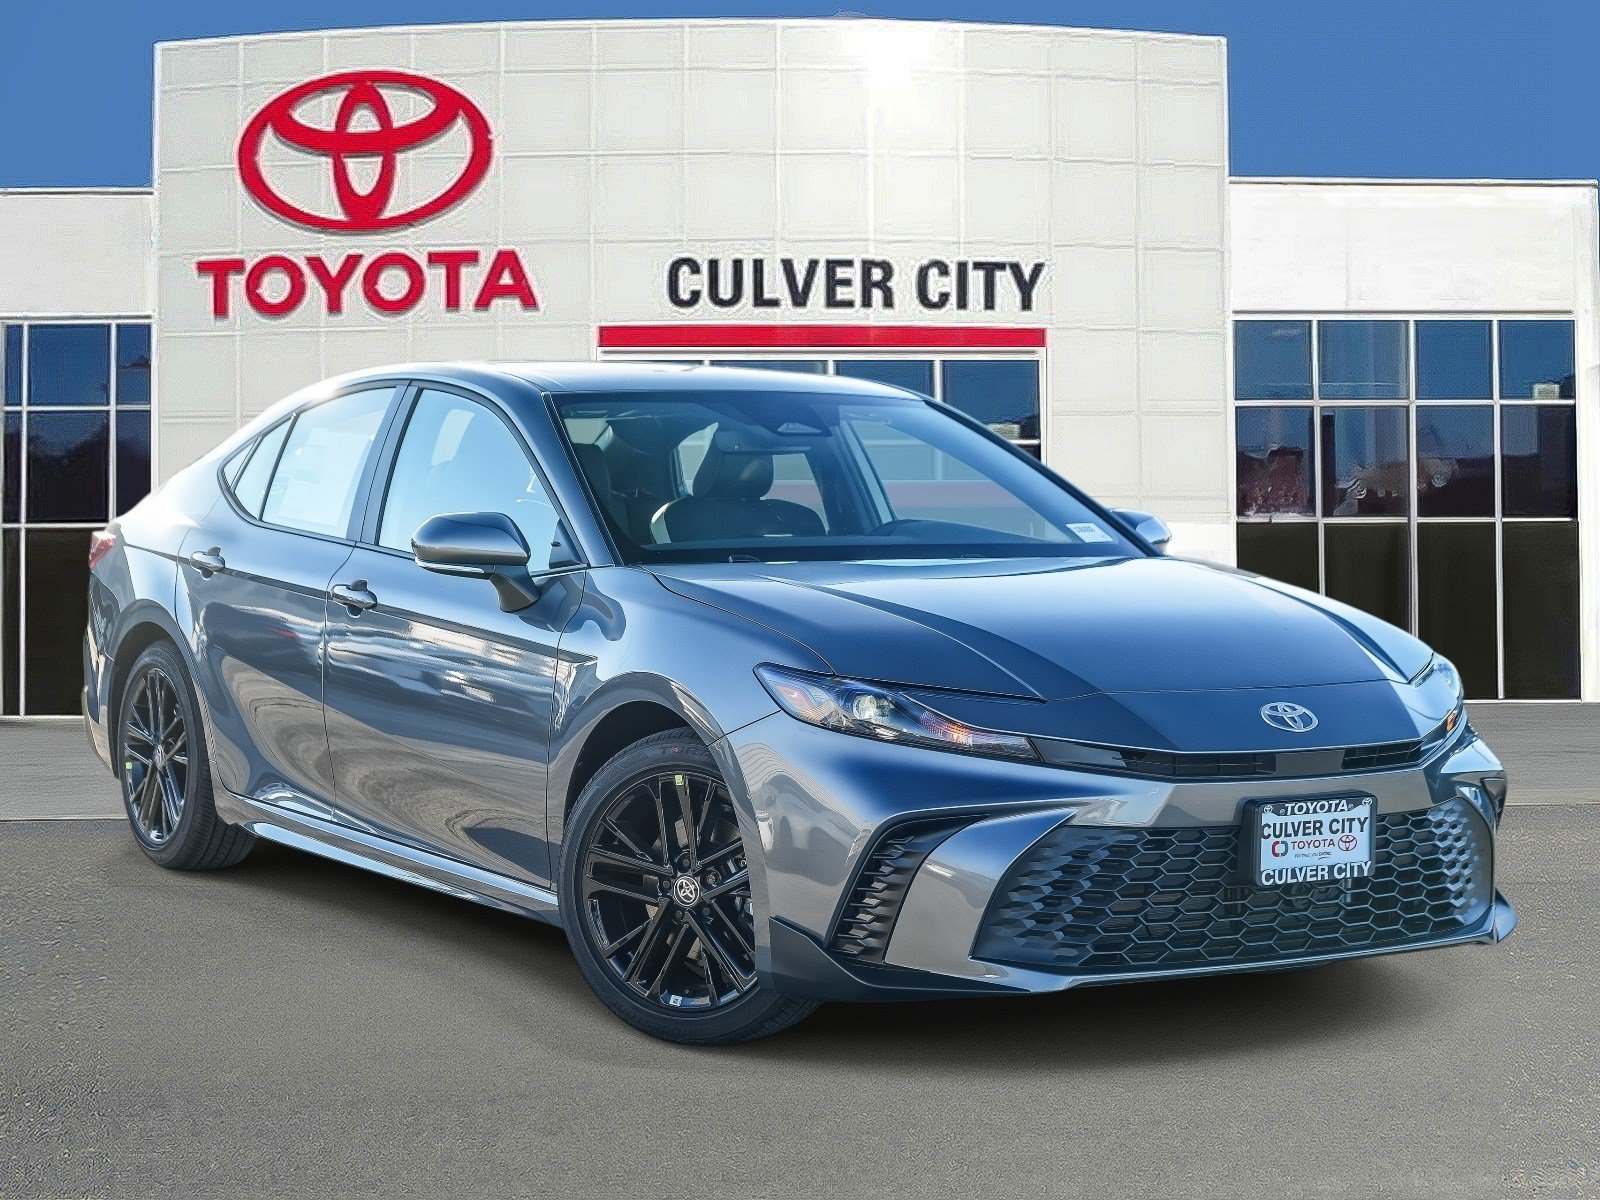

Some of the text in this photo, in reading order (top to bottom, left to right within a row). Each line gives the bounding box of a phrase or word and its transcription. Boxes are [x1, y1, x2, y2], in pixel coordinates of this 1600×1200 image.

[196, 249, 539, 319] TOYOTA
[668, 256, 1046, 311] CULVER CITY
[1285, 800, 1348, 816] TOYOTA
[1262, 816, 1369, 840] CULVER CITY
[1291, 839, 1335, 850] TOYOTA
[1262, 860, 1372, 886] CULVER CITY
